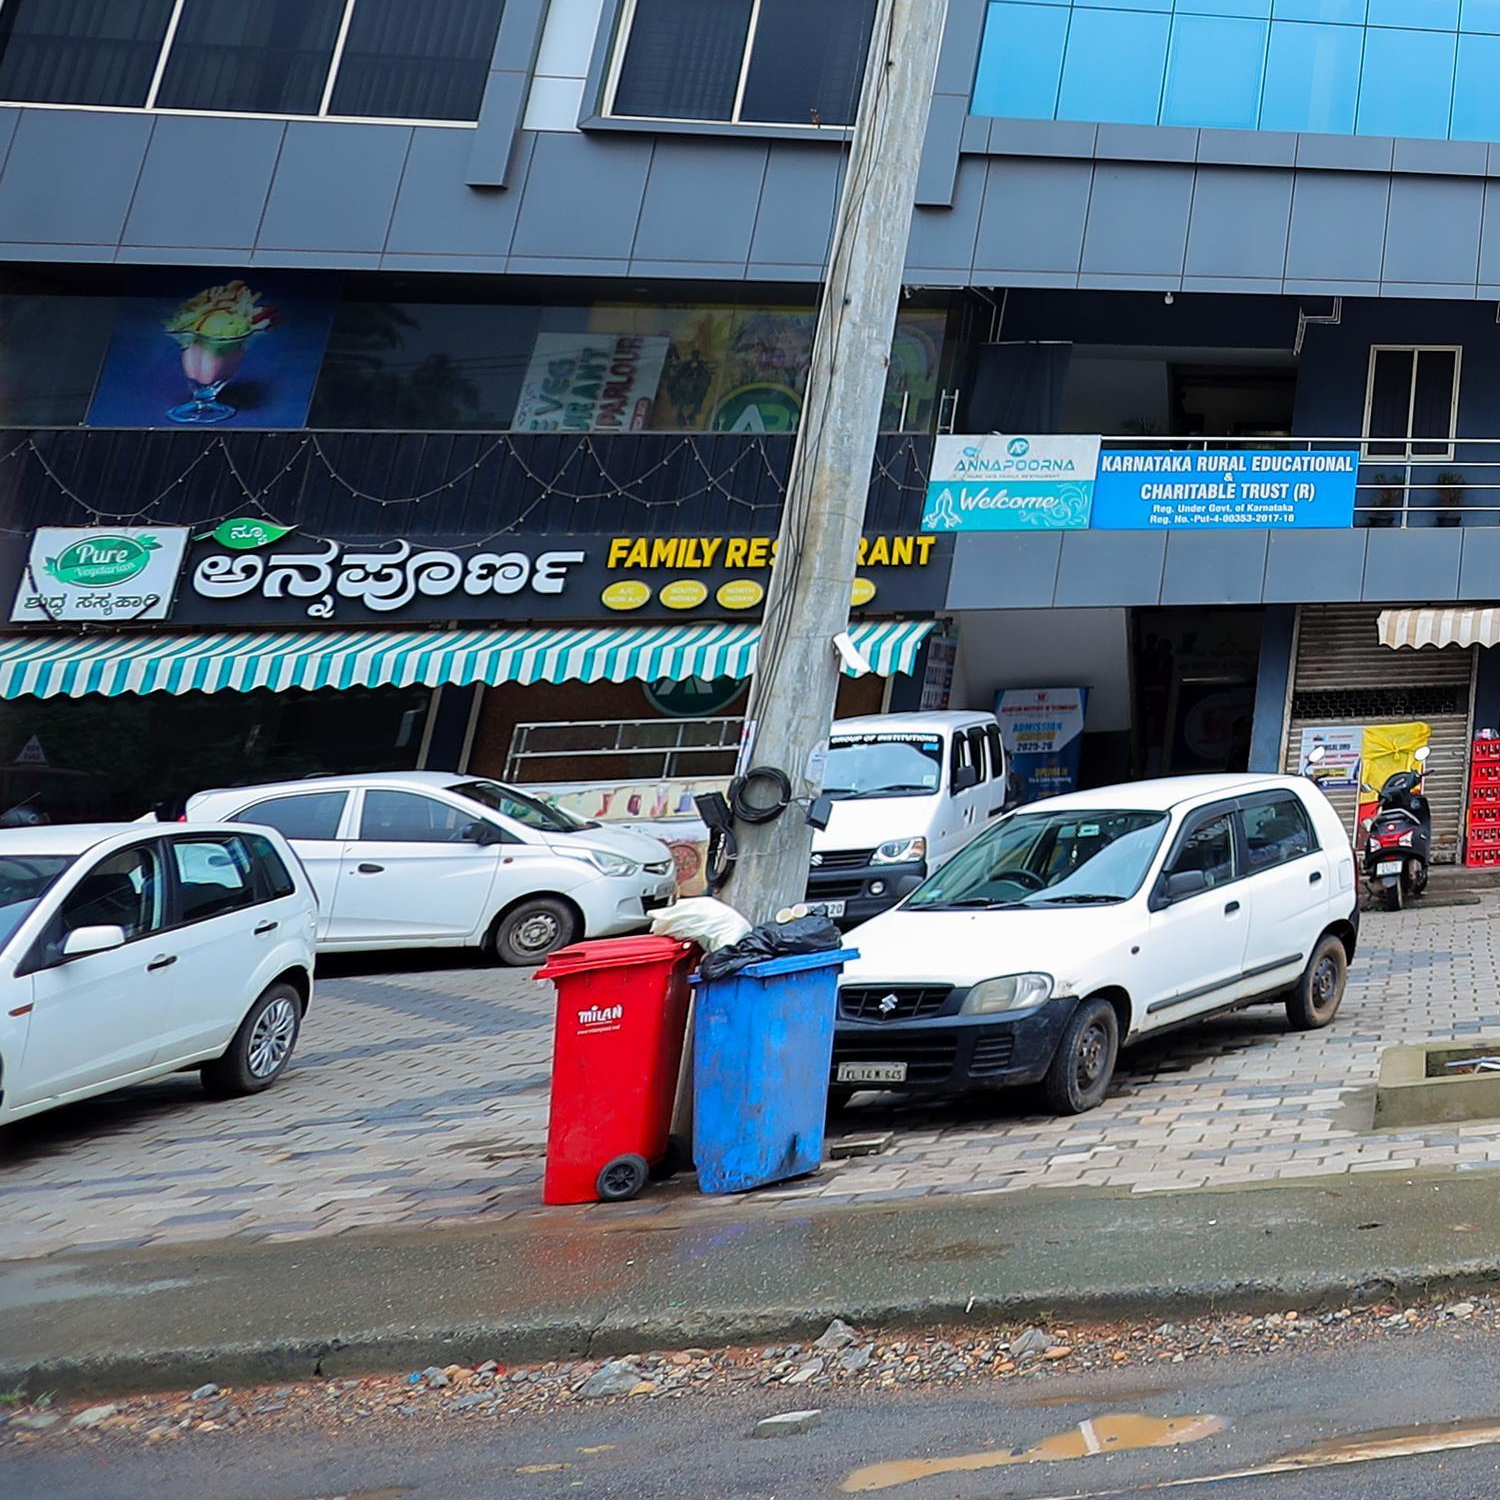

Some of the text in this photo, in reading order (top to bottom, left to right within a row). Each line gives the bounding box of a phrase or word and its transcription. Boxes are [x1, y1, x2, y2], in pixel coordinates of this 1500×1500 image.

[954, 459, 1075, 471] ANNAPOORNA
[1101, 456, 1353, 472] KARNATAKA RURAL EDUCATIONAL
[960, 486, 1059, 511] Welcome
[1141, 483, 1316, 502] CHARITABLE TRUST (R)
[1153, 504, 1174, 514] Reg.
[1178, 504, 1206, 513] Under
[1247, 503, 1294, 512] Karnataka
[1150, 515, 1171, 525] Reg.
[76, 544, 128, 565] Pure
[607, 538, 722, 569] FAMILY
[74, 560, 137, 577] Vegetarian
[193, 538, 585, 619] ಅನ್ನಪೂರ್ಣ
